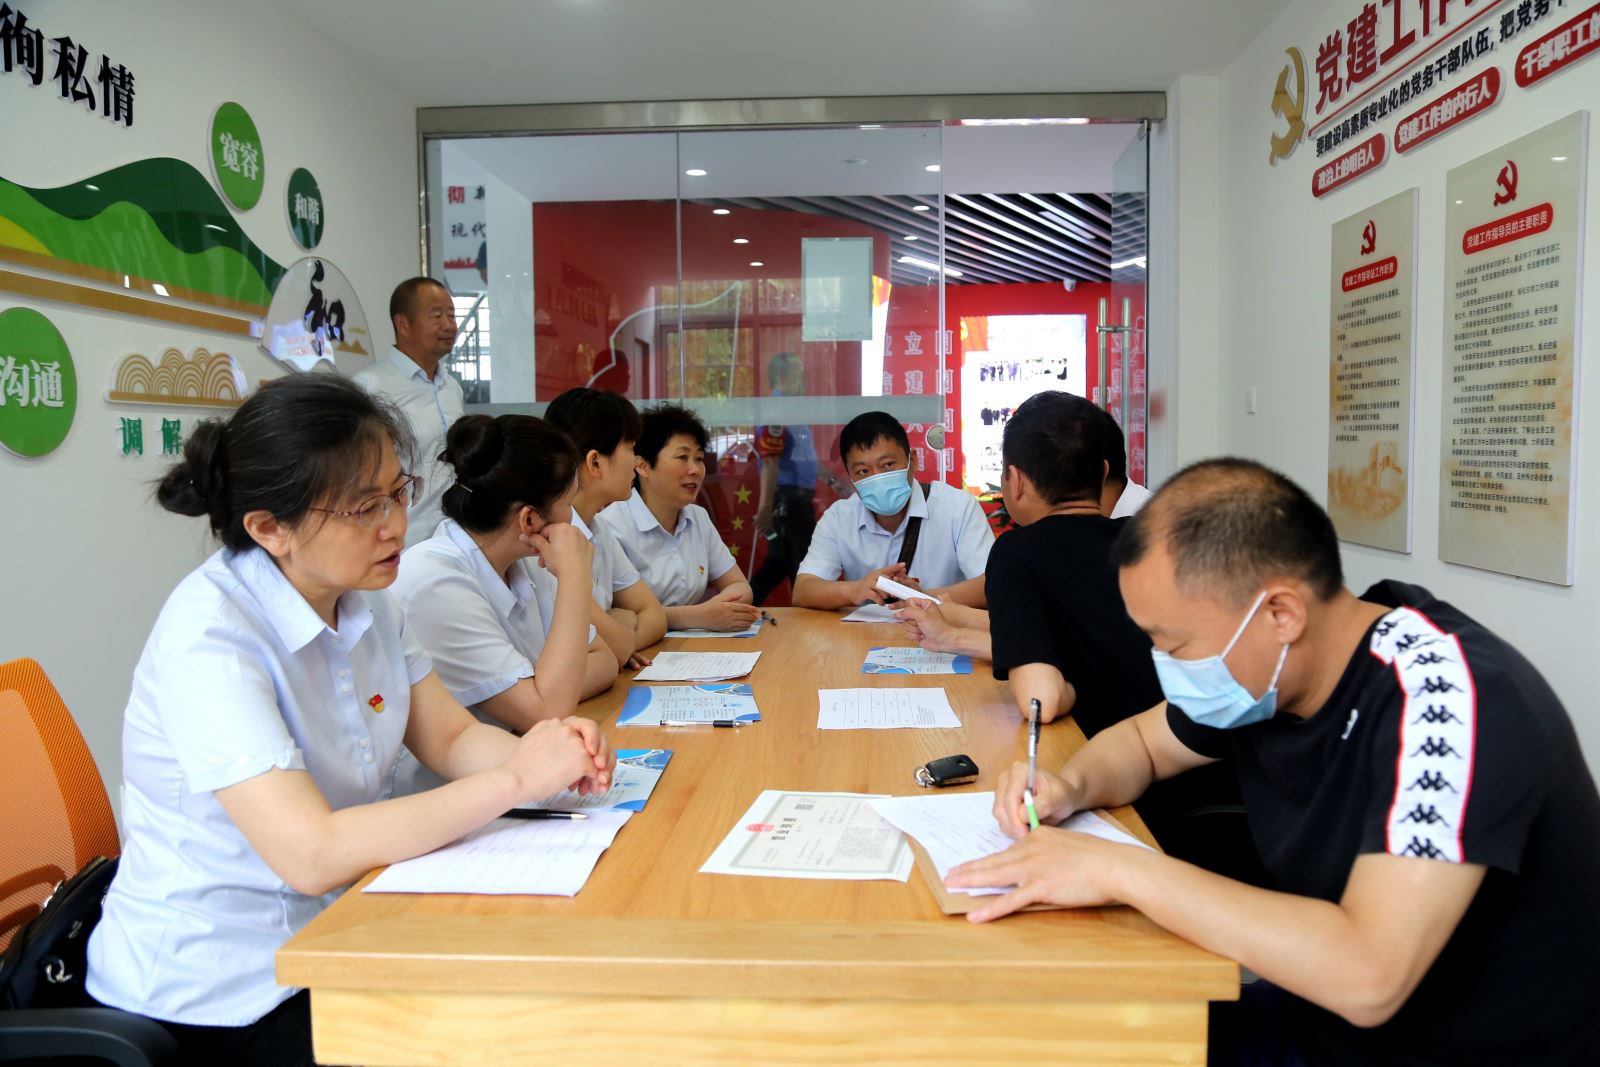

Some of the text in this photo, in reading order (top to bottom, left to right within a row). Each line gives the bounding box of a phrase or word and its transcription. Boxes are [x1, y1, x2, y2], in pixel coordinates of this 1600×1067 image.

[1398, 76, 1491, 148] 党建工作的内行人
[219, 132, 258, 181] 宽容
[1318, 143, 1375, 190] 政治上的明白人
[294, 192, 320, 225] 和谐
[1466, 210, 1548, 249] 党建工作指导员的主要职责
[0, 355, 65, 408] 沟通
